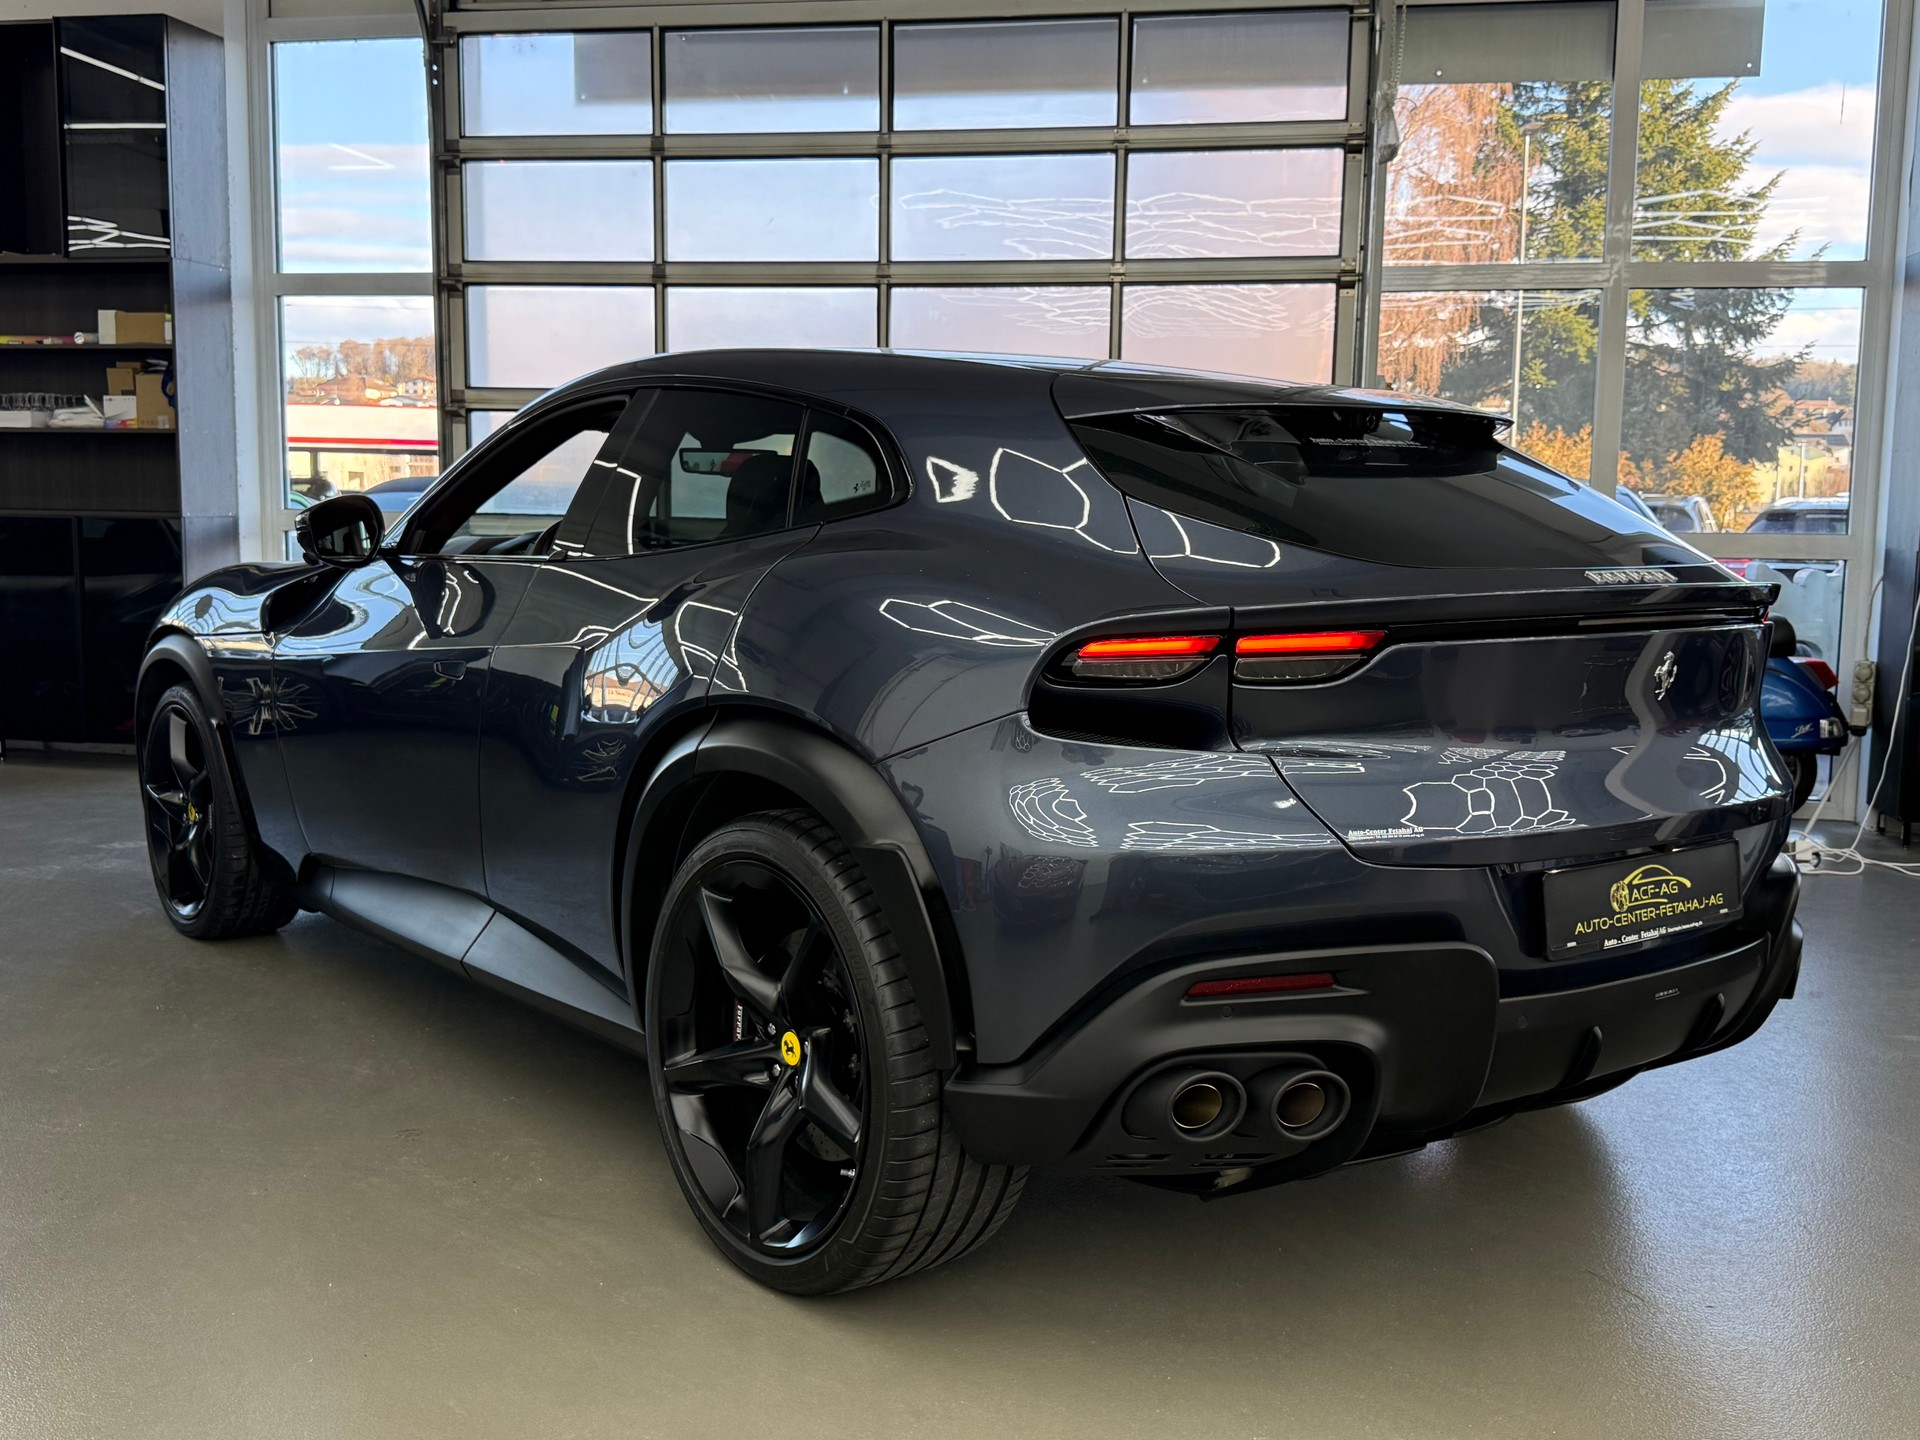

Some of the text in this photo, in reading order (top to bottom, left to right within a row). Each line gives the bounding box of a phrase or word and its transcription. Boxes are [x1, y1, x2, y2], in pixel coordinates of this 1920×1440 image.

[1631, 881, 1678, 901] ACF-AG
[1575, 893, 1724, 935] AUTO-CENTER-FETAHAJ-AG
[1621, 933, 1639, 943] Center
